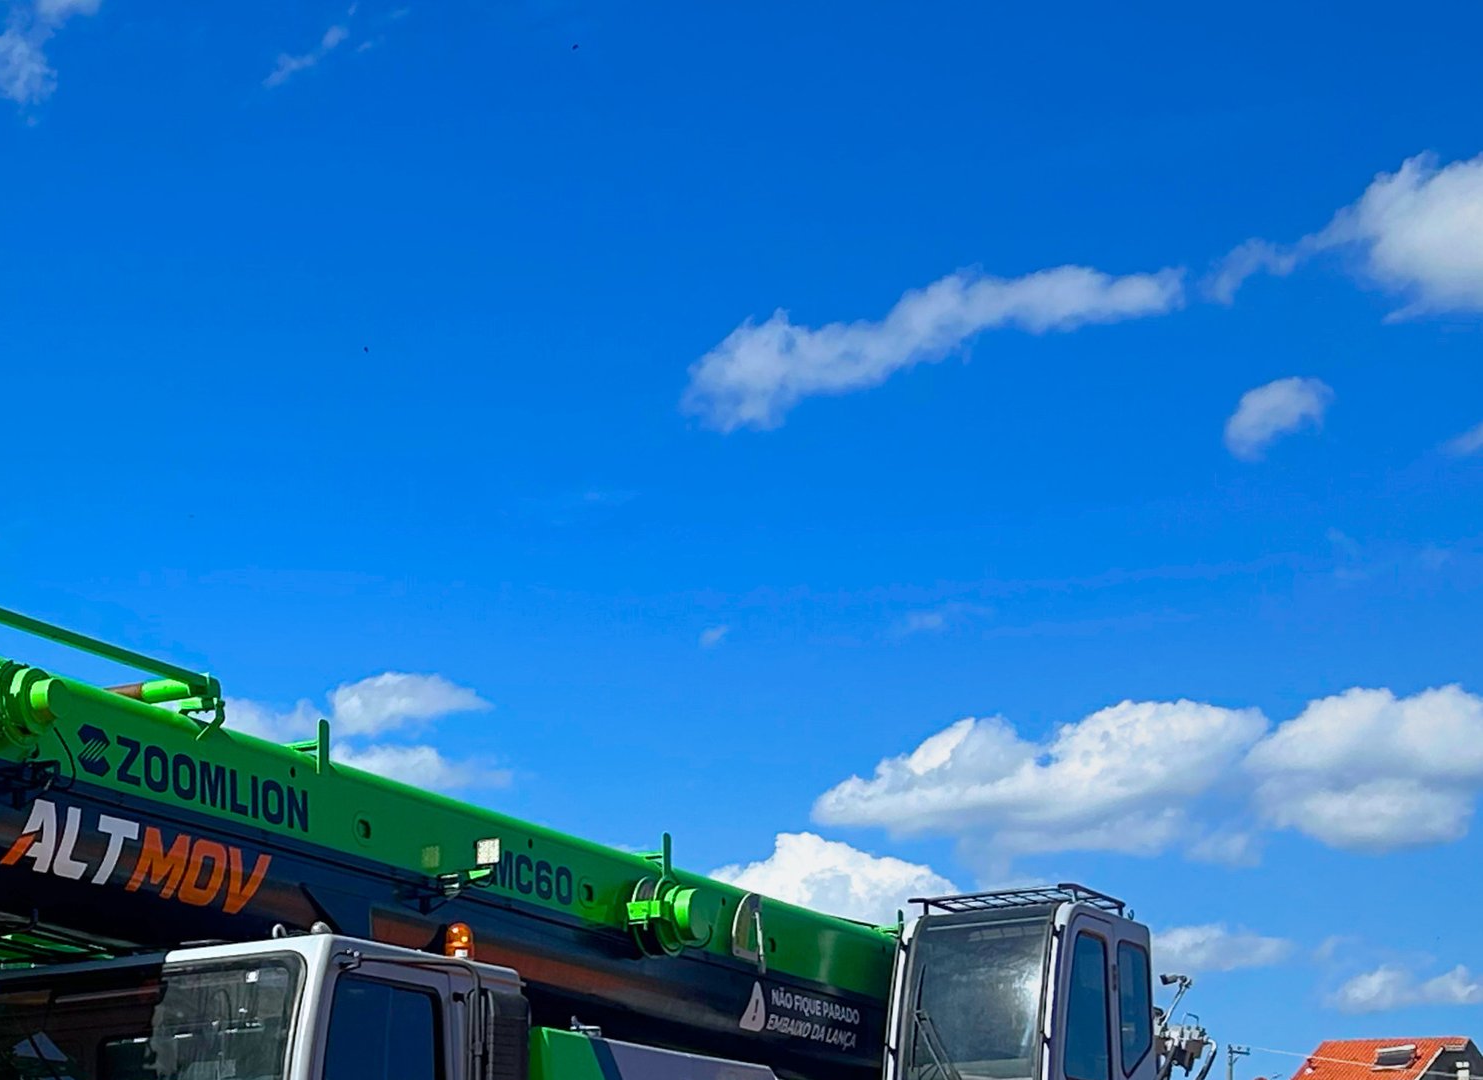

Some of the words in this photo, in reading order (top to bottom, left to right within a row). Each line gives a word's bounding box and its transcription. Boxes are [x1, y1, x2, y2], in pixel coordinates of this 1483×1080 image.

[116, 737, 309, 833] ZOOMLION
[0, 799, 272, 914] ALTMOV
[766, 1013, 812, 1038] EMBAIXO
[810, 1024, 826, 1042] DA
[825, 1027, 857, 1052] LANÇA
[770, 987, 793, 1009] NÃO
[793, 994, 822, 1017] FIQUE
[822, 1001, 860, 1025] PARADO
